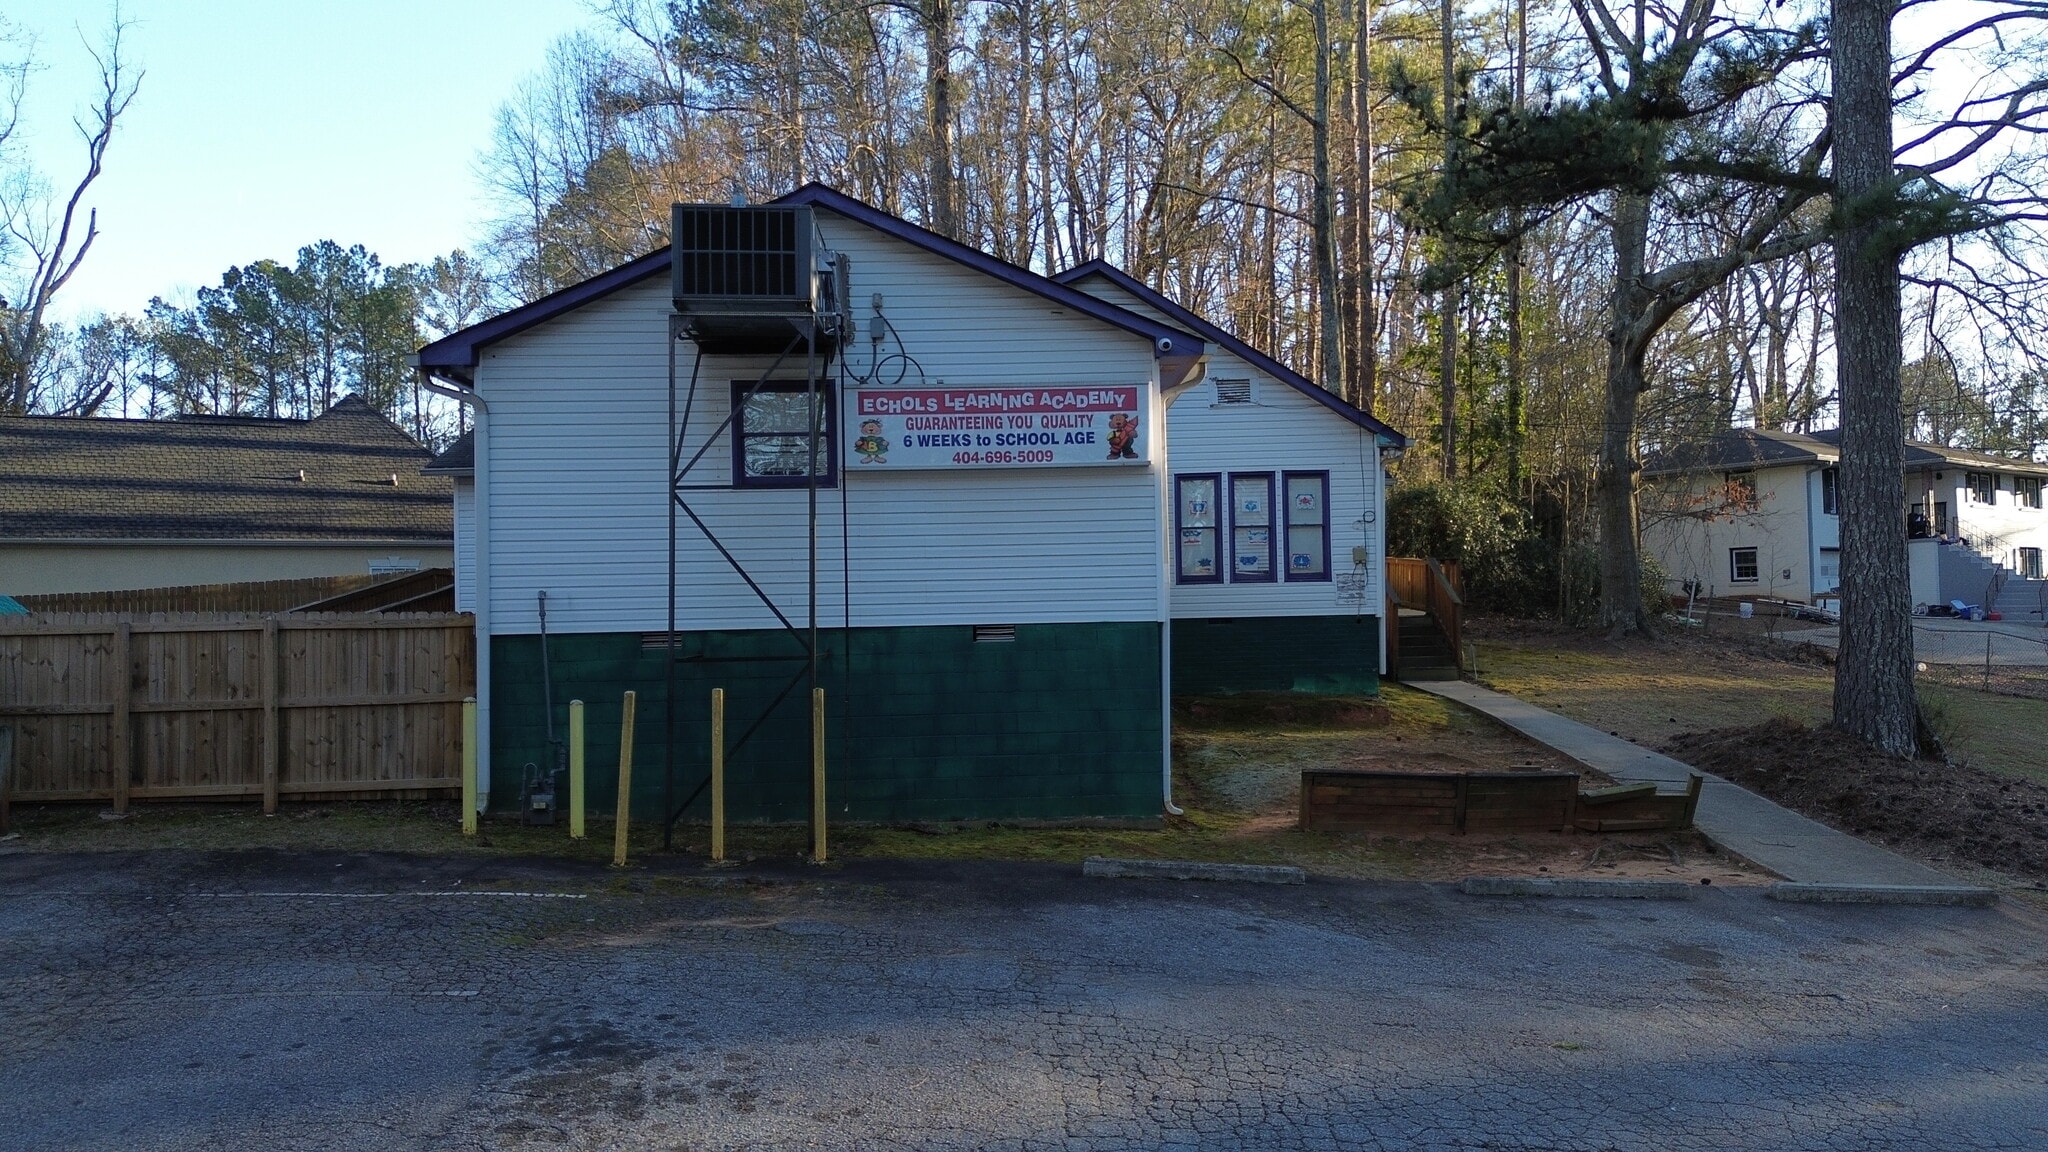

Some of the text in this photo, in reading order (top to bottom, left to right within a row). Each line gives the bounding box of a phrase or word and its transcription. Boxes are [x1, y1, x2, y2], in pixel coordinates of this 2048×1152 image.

[863, 391, 1126, 413] ECHOLS LEARNING ACADEMY
[905, 415, 1094, 430] GUARANTEEING YOU QUALITY
[903, 432, 1095, 447] 6 WEEKS to SCHOOL AGE
[952, 450, 1053, 464] 404-696-5009
